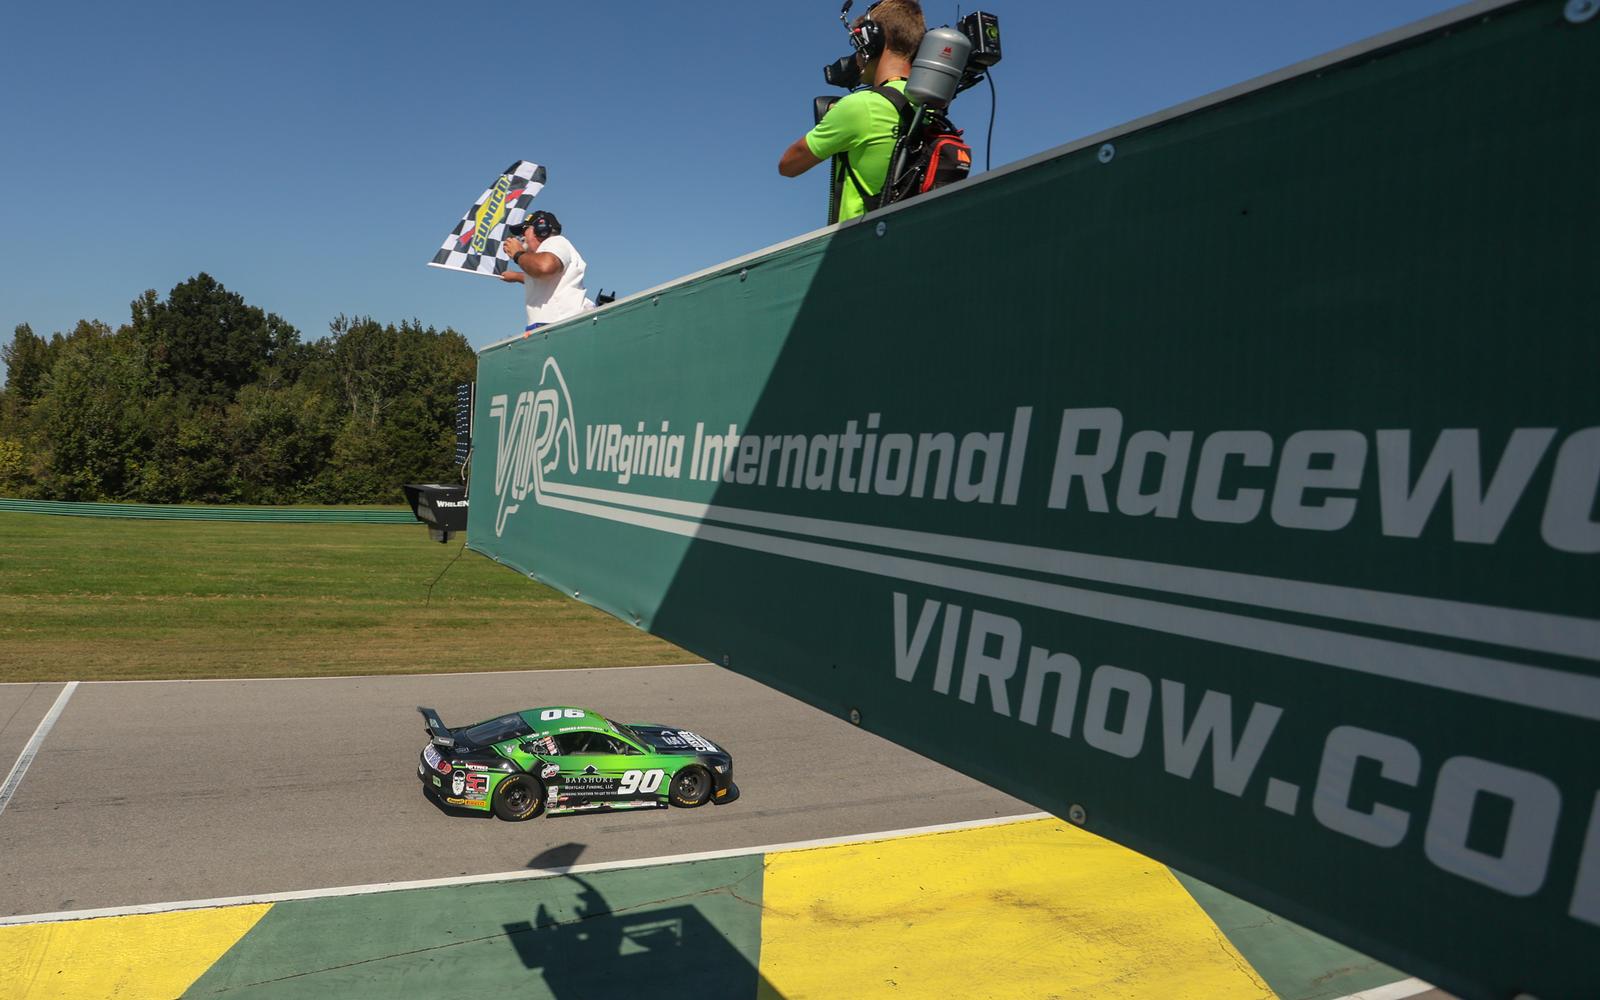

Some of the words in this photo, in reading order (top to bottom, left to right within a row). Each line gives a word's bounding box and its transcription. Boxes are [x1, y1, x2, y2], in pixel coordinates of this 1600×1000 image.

[474, 178, 509, 250] SUNOCO
[586, 420, 685, 485] VIRginia
[689, 406, 1034, 506] International
[565, 776, 614, 784] BAYSHORE
[617, 769, 665, 795] 90
[892, 591, 1600, 927] VIRnow.co
